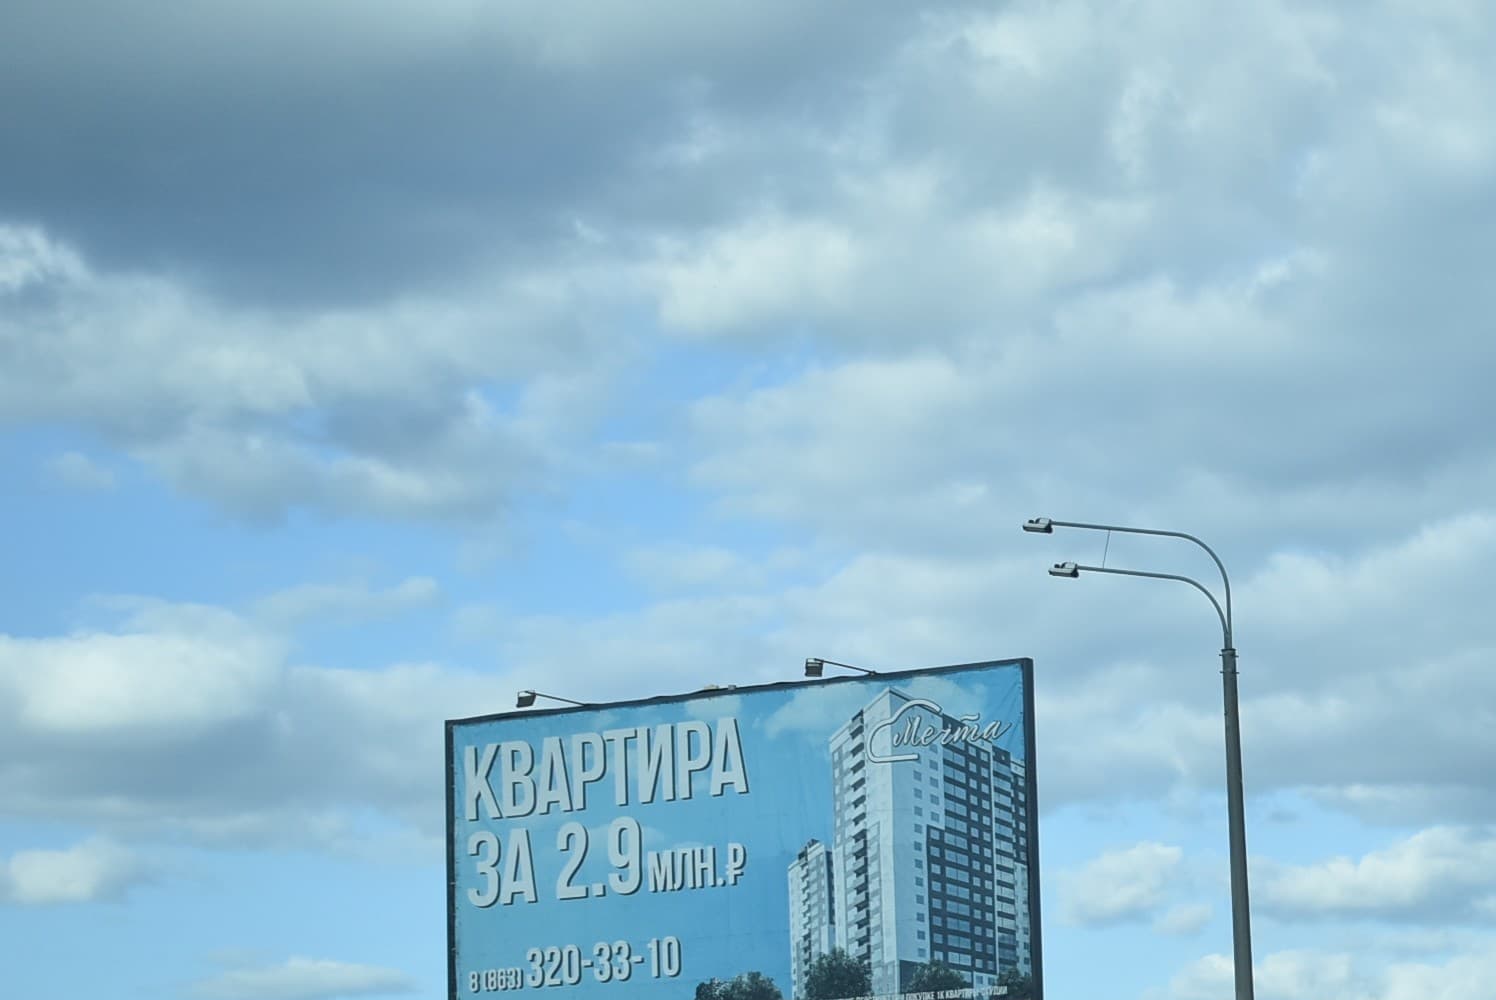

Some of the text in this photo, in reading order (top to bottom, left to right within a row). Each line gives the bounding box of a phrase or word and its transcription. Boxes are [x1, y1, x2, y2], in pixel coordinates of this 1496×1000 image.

[892, 711, 1012, 747] Мечта
[463, 716, 749, 821] КВАРТИРА
[466, 827, 538, 908] ЗА
[556, 816, 643, 901] 2.9
[469, 935, 682, 993] 8 (863) 320-33-10
